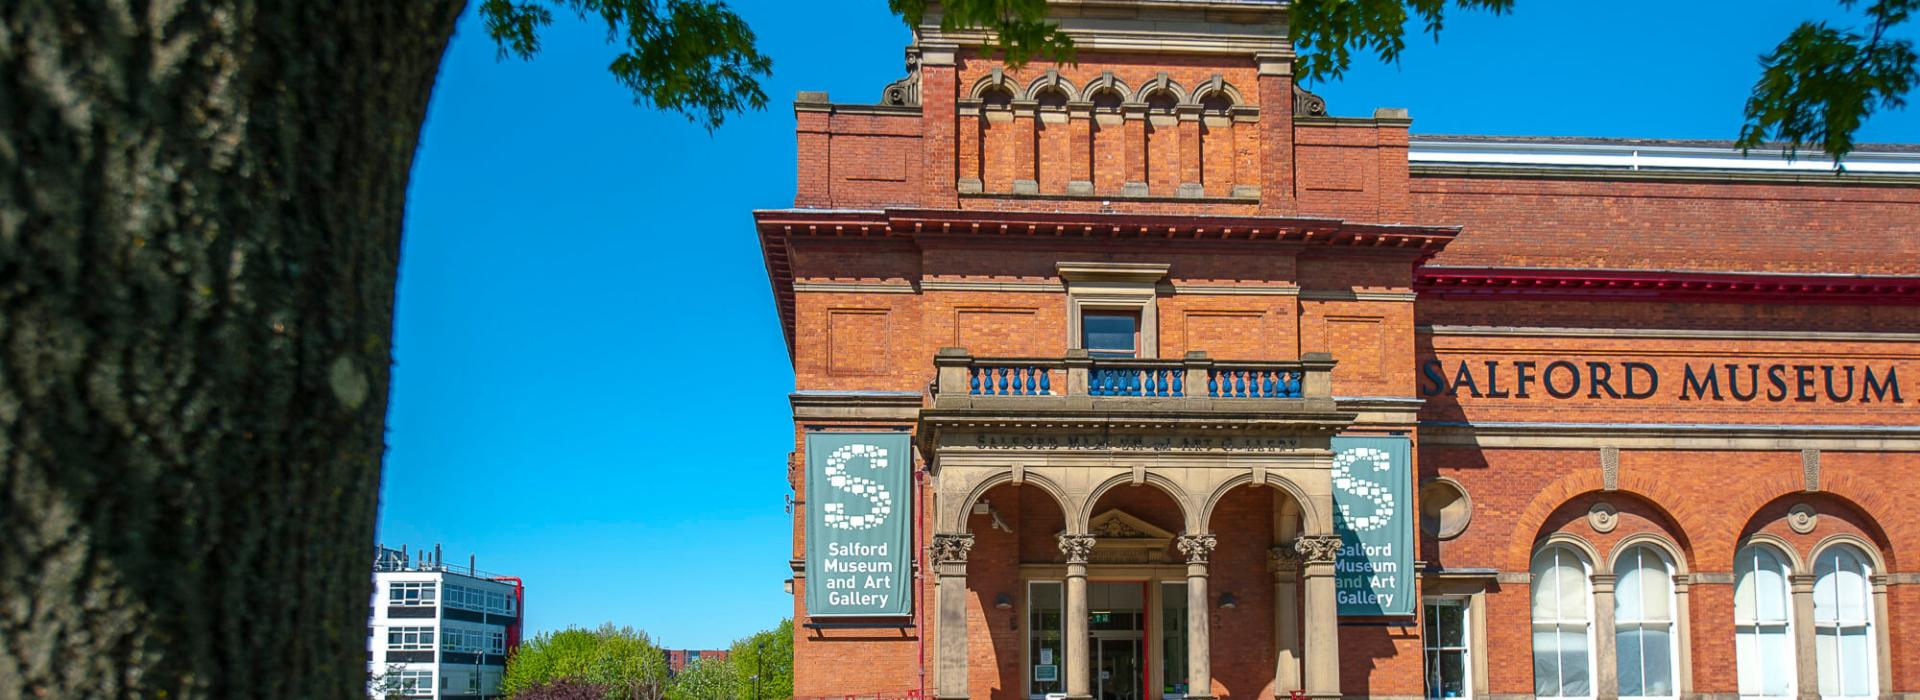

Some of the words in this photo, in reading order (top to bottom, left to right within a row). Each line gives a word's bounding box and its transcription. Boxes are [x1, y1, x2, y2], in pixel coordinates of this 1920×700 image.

[1422, 359, 1658, 399] SALFORD
[1678, 363, 1904, 403] MUSEUM
[828, 542, 888, 556] Salford
[824, 559, 893, 572] Museum
[1335, 559, 1397, 573] Museum
[826, 575, 856, 589] and
[863, 576, 891, 589] Art
[1336, 575, 1362, 588] and
[1370, 575, 1395, 588] Art
[828, 591, 889, 608] Gallery
[1337, 590, 1394, 608] Gallery
